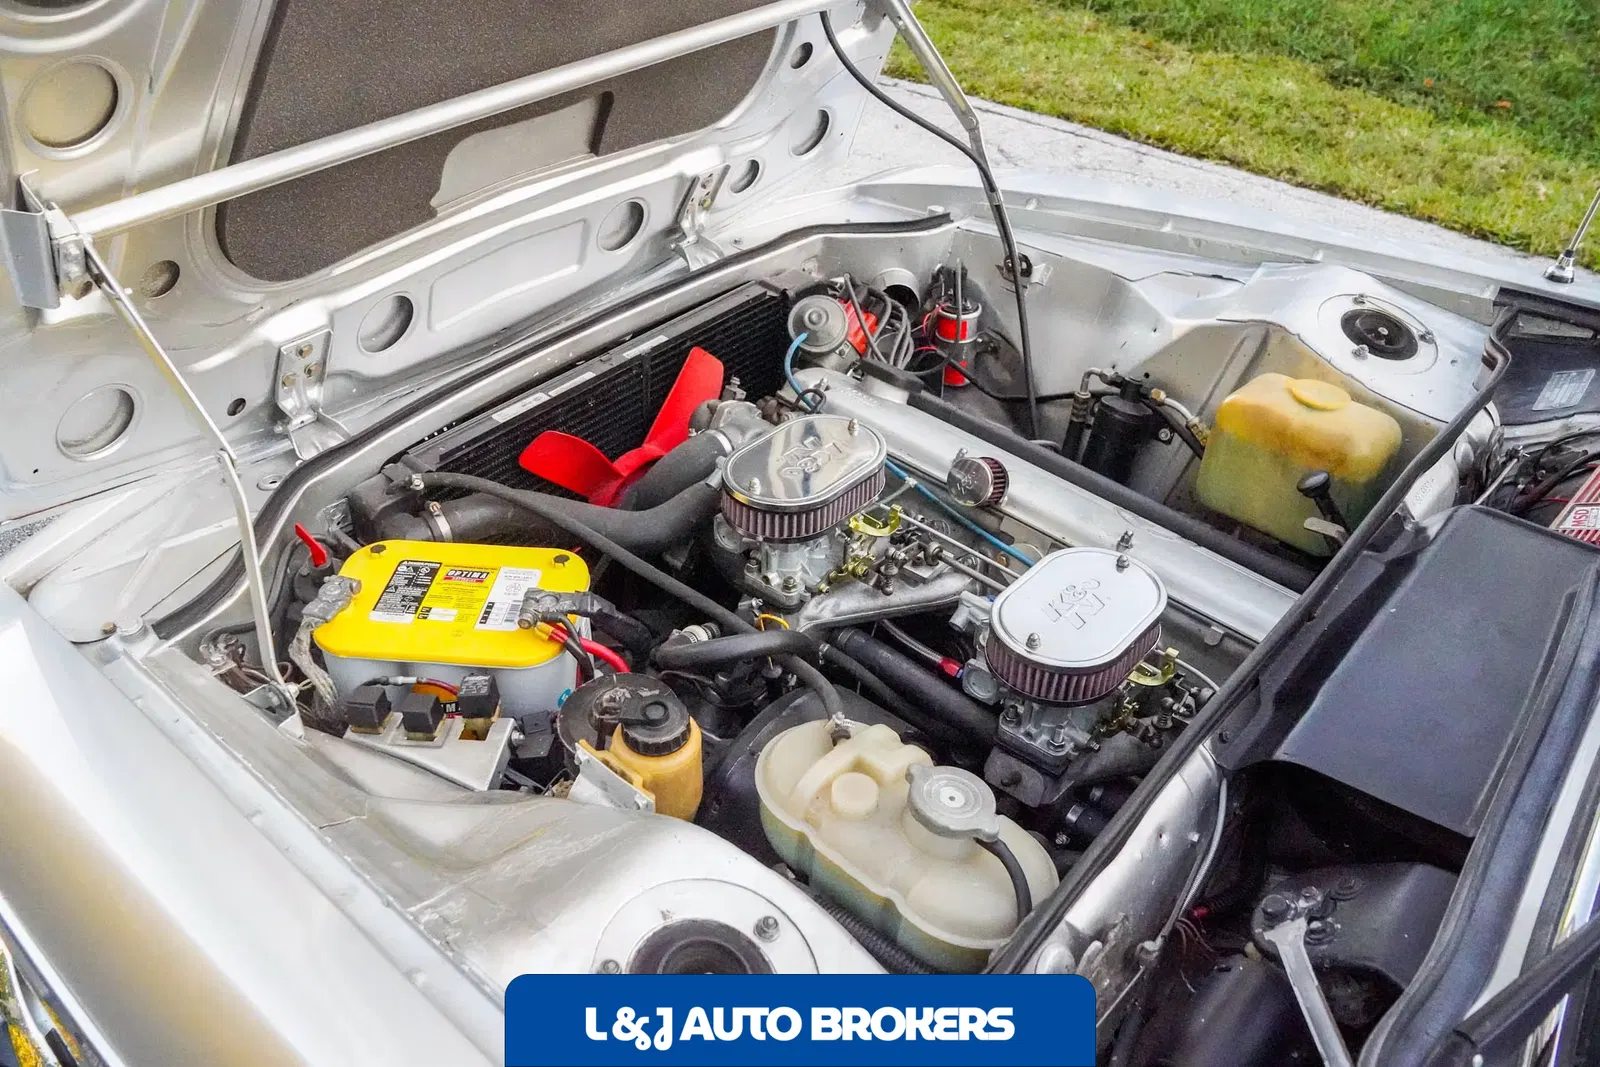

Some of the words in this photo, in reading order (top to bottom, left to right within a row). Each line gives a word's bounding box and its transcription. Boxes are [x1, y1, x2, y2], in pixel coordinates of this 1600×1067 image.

[1571, 509, 1590, 527] MSD
[447, 570, 488, 579] OPTIMA
[1041, 577, 1105, 630] K&N
